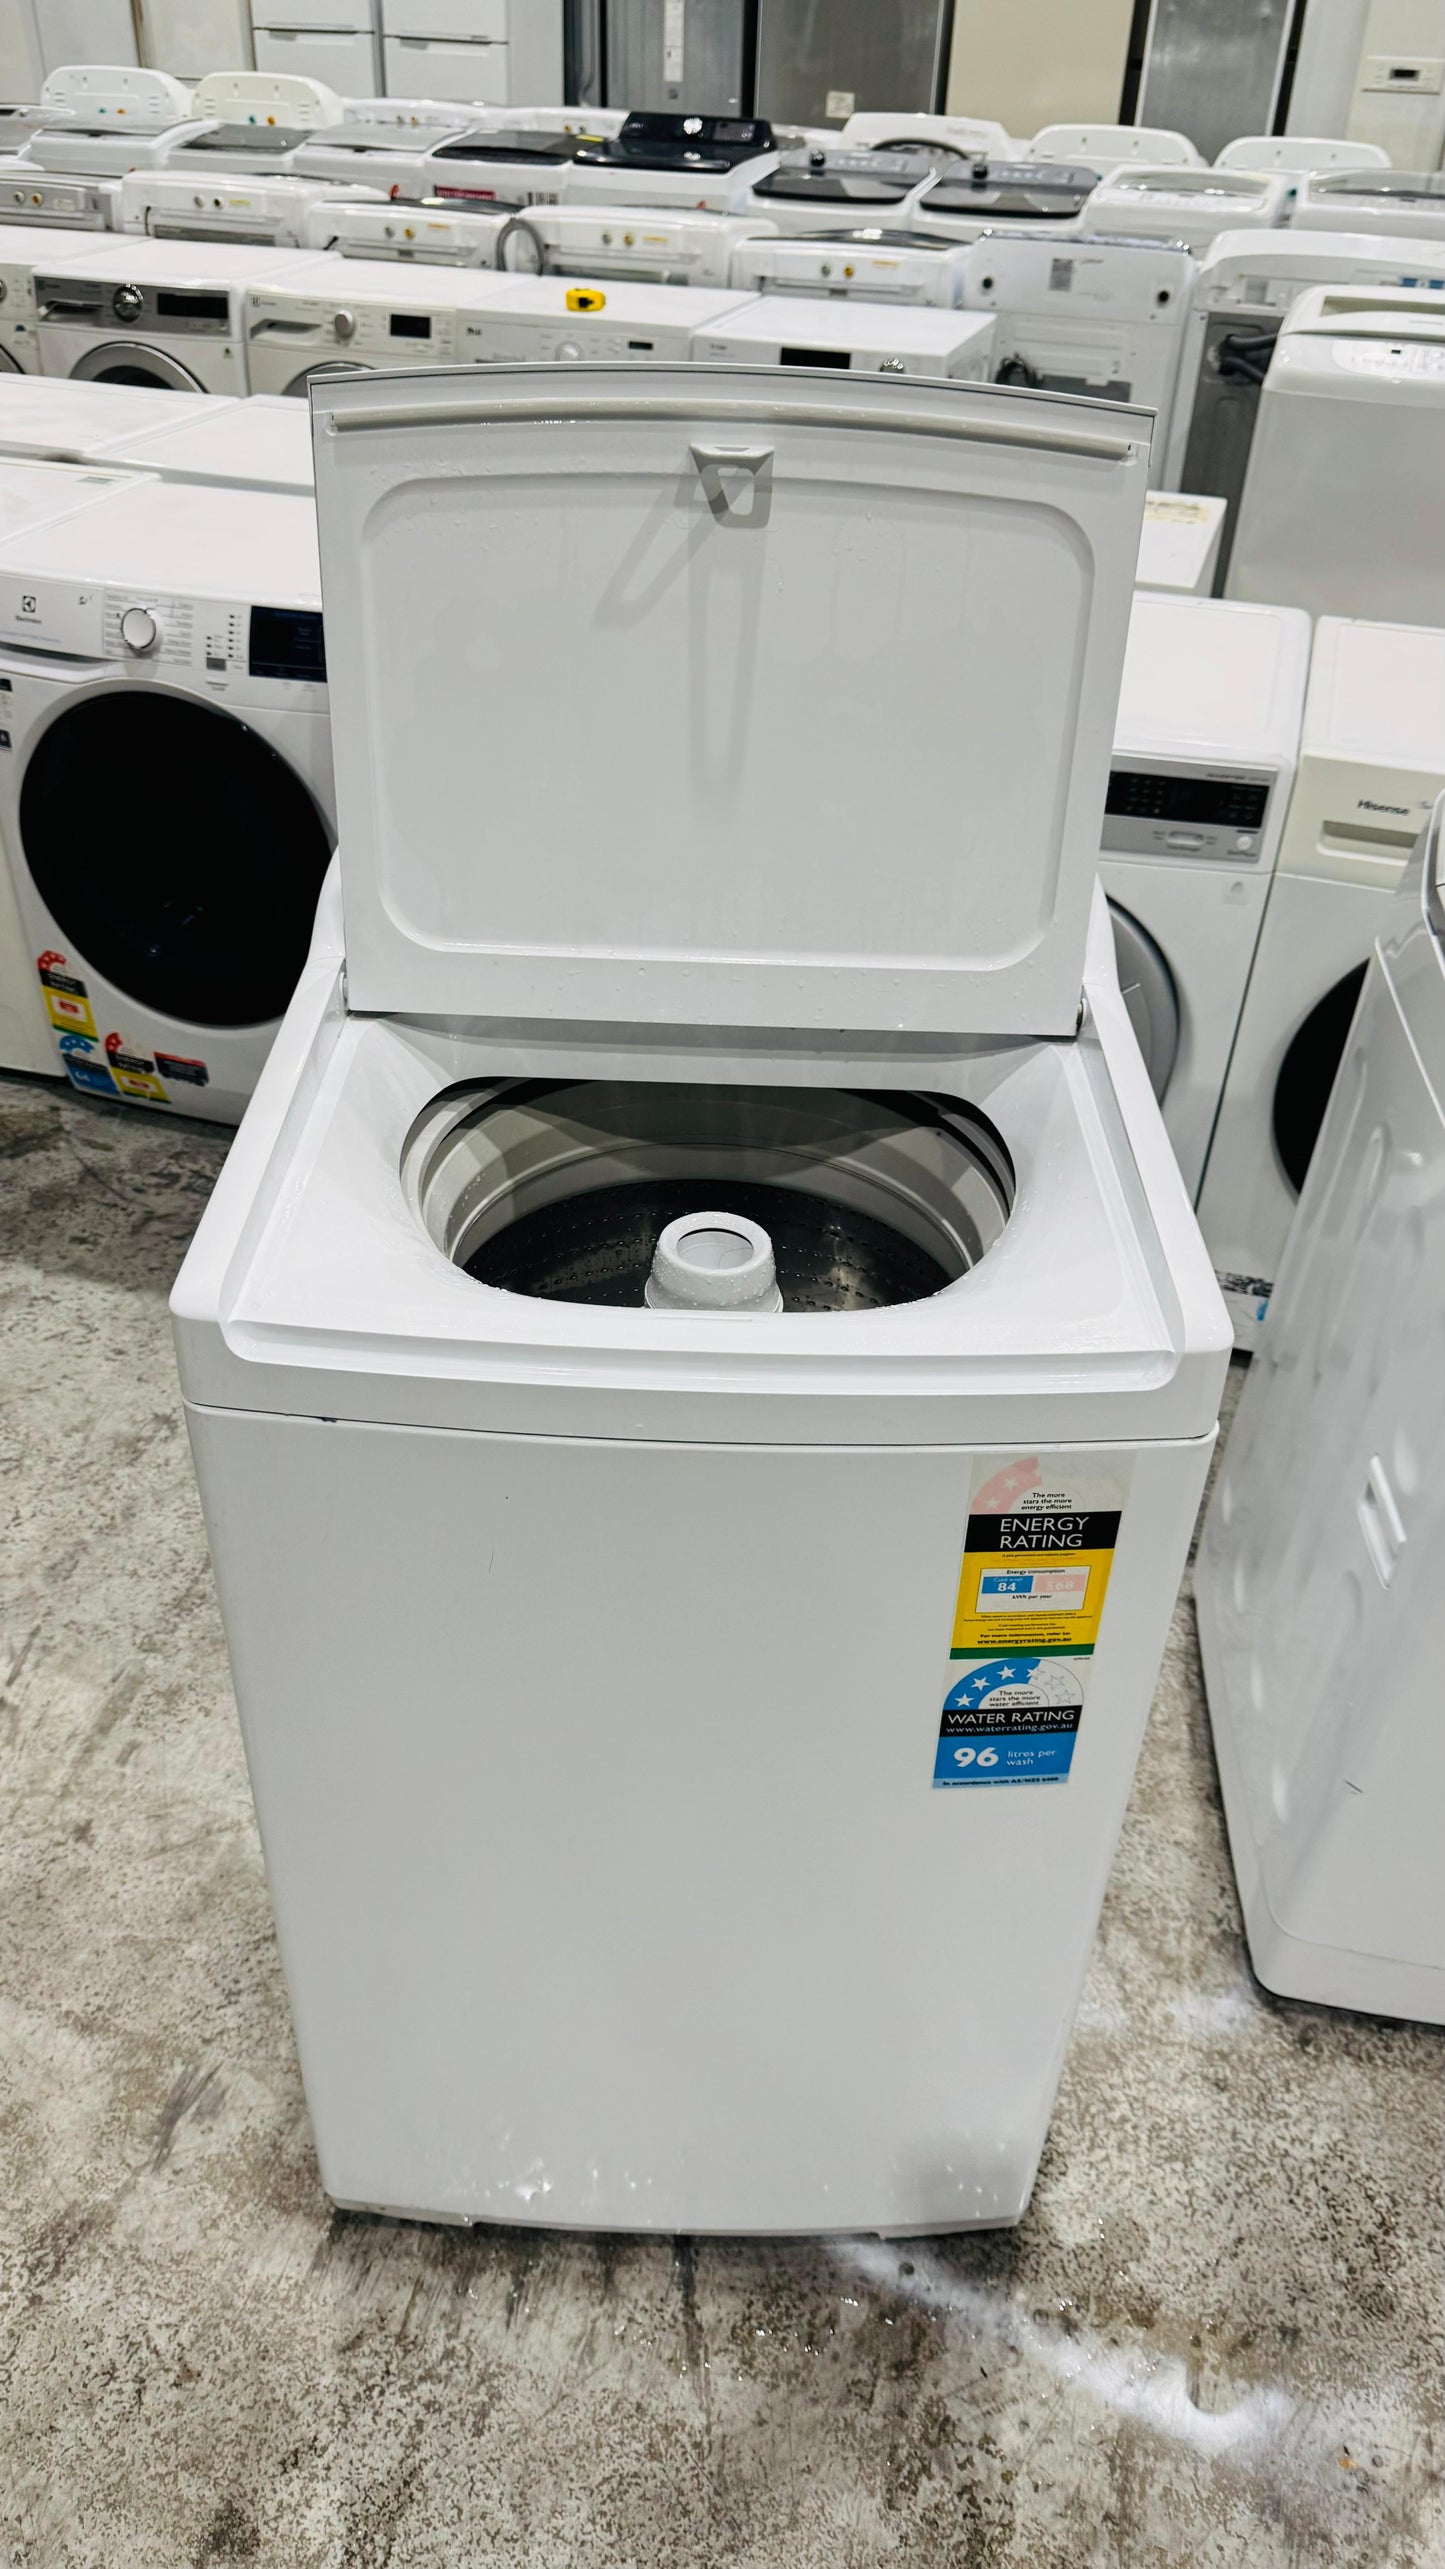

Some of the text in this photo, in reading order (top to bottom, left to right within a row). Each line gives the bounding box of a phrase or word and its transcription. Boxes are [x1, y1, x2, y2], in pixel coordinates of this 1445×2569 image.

[1356, 799, 1411, 816] Hisense
[1000, 1516, 1090, 1532] ENERGY
[1000, 1533, 1083, 1549] RATING
[997, 1582, 1016, 1592] 84
[977, 1636, 1072, 1645] www.energyrating.gov.au
[948, 1710, 1075, 1724] WATER RATING
[946, 1722, 1073, 1734] www.waterrating.gov.au
[953, 1746, 999, 1768] 96
[1007, 1749, 1057, 1758] litres per
[1006, 1758, 1034, 1766] wash
